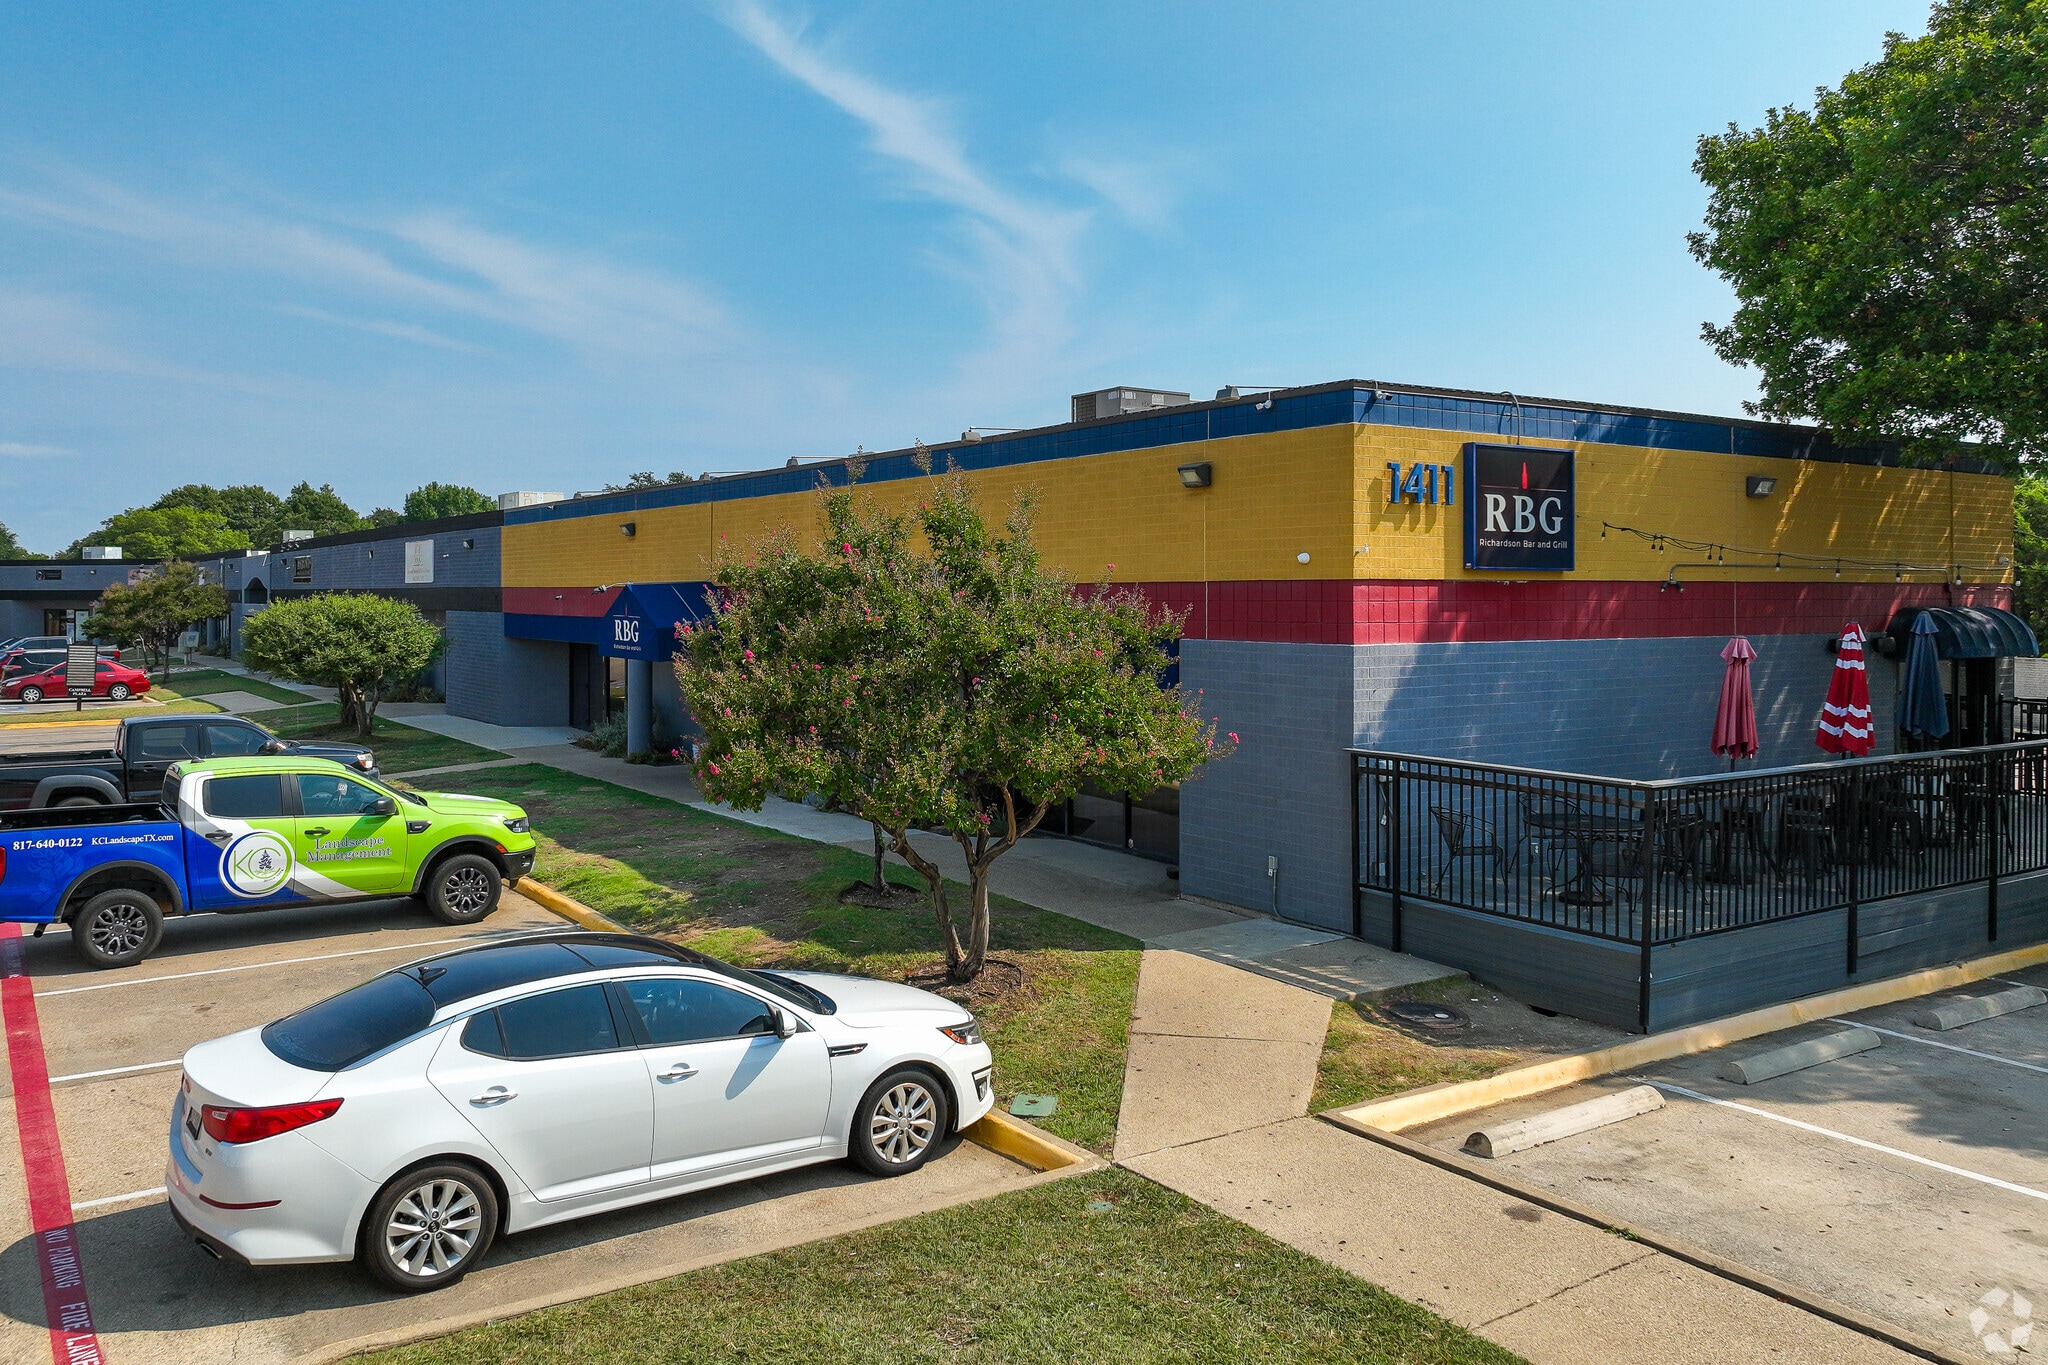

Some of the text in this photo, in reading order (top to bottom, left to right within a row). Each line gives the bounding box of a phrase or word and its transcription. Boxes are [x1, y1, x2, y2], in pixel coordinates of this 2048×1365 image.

[1387, 462, 1454, 505] 1411
[1484, 493, 1563, 535] RBG
[1479, 538, 1568, 549] Richardson Bar and Grill
[614, 619, 640, 643] RBG
[13, 834, 174, 850] 817-640-0122 KCLandscapeTX.com
[315, 836, 384, 850] Landscape
[233, 847, 282, 881] KC
[306, 847, 392, 863] Management
[45, 1228, 69, 1244] NO
[48, 1246, 81, 1289] PARKING
[60, 1301, 91, 1332] FIRE
